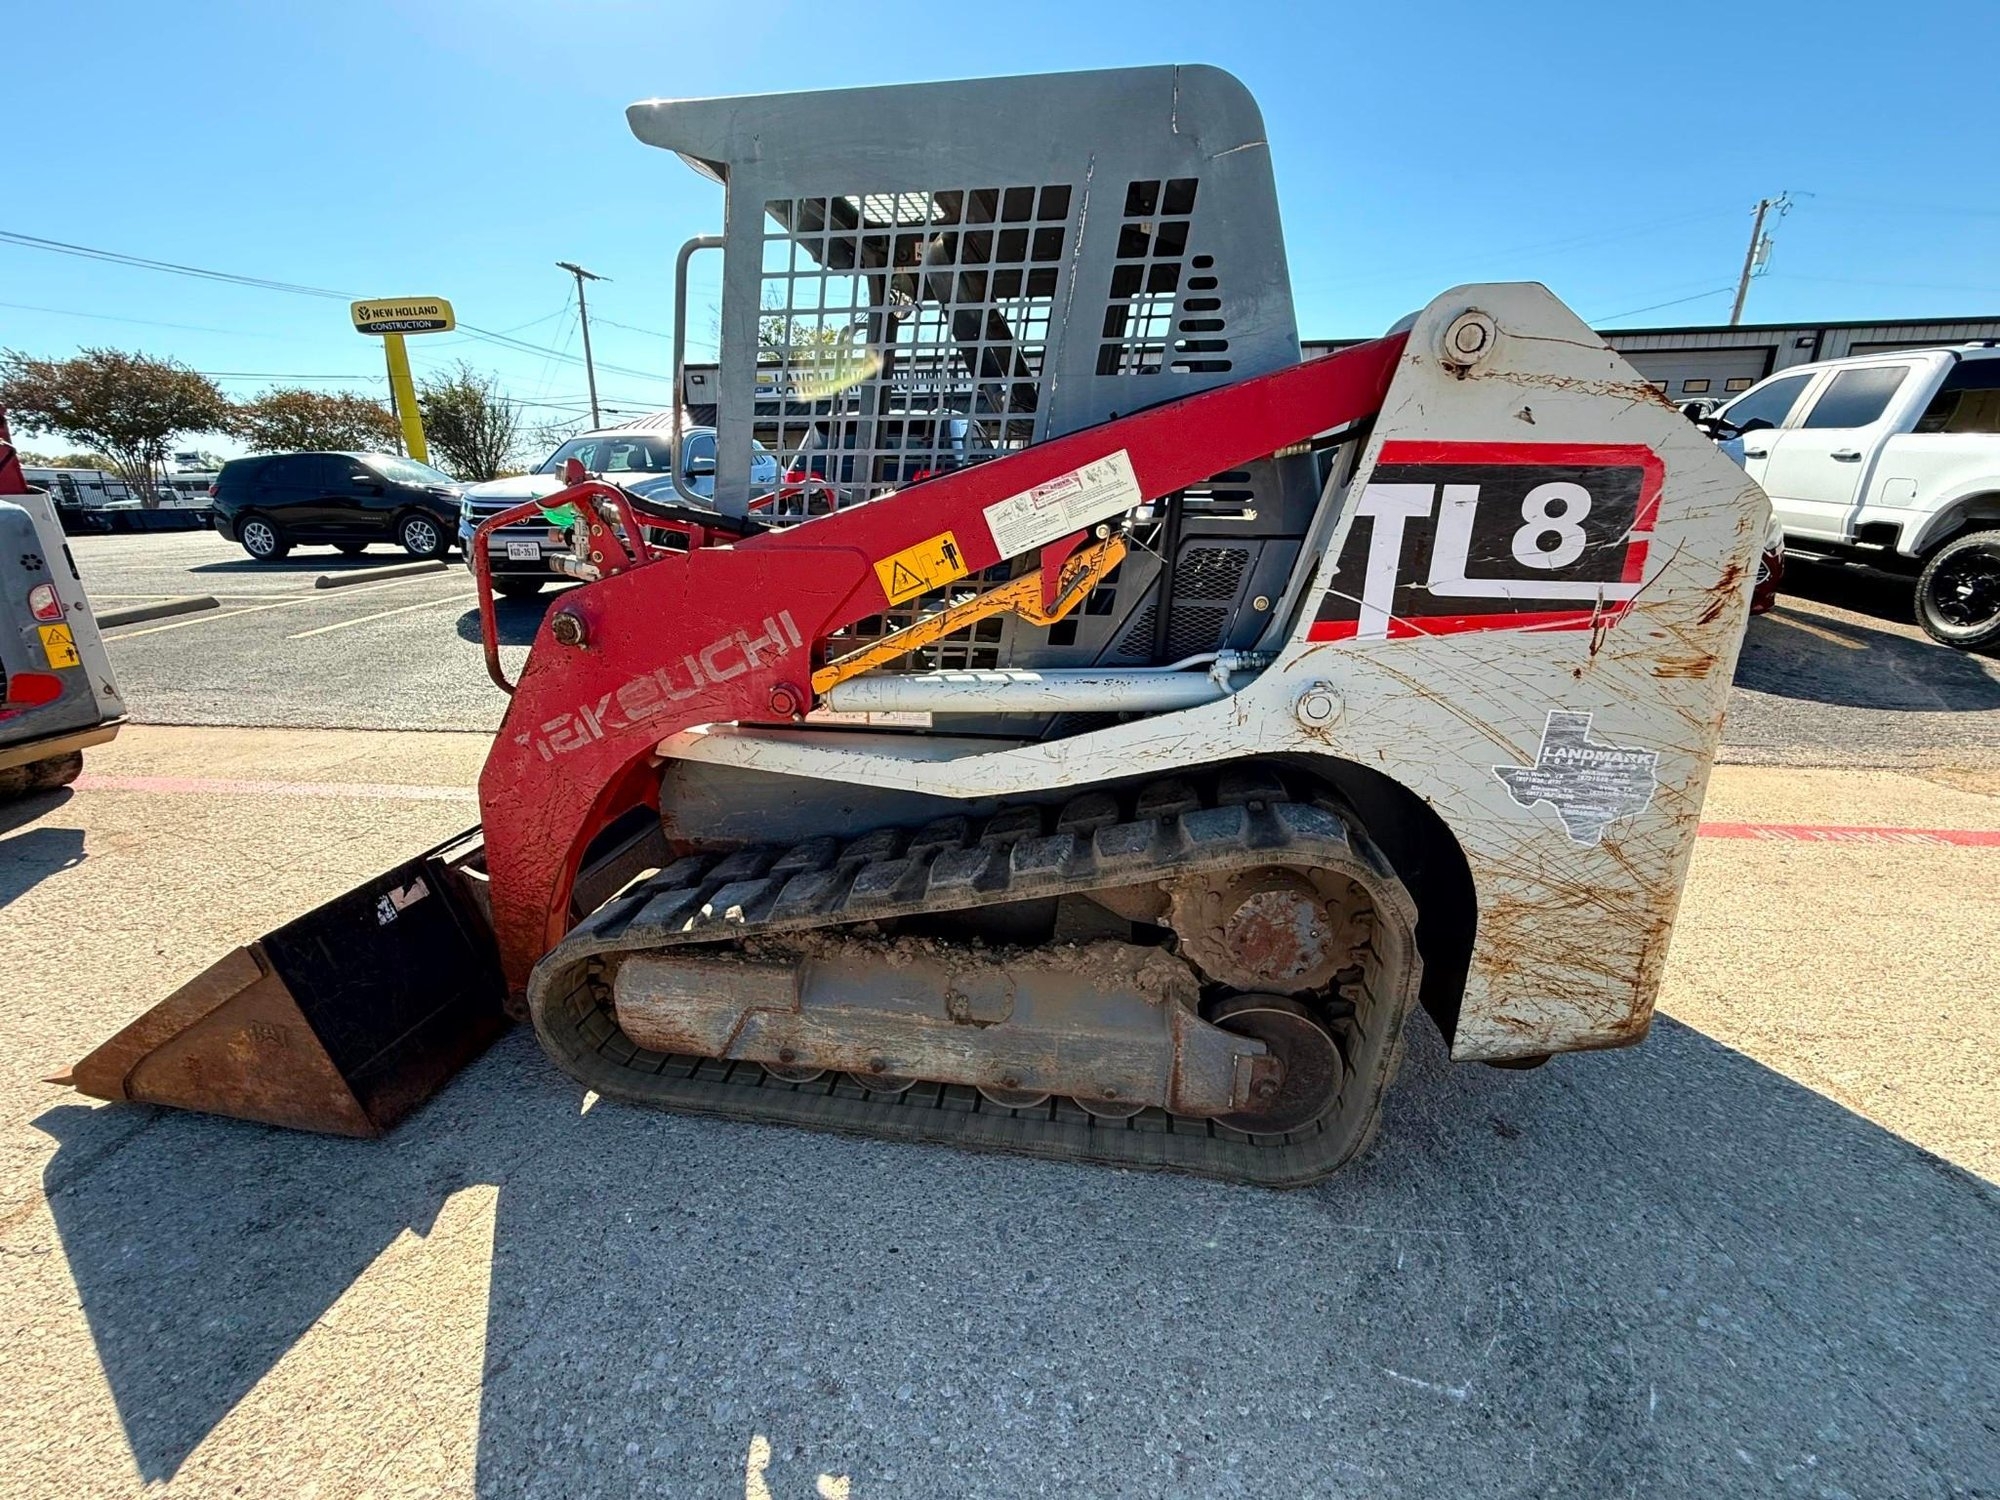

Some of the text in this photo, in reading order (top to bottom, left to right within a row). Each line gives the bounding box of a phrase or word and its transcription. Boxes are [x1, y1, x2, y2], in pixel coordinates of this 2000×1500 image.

[372, 305, 438, 318] NEW HOLLAND
[370, 320, 432, 331] CONSTRUCTION
[774, 371, 862, 395] LANDMK
[1355, 481, 1641, 641] TL8
[1543, 746, 1653, 765] LANDMARK
